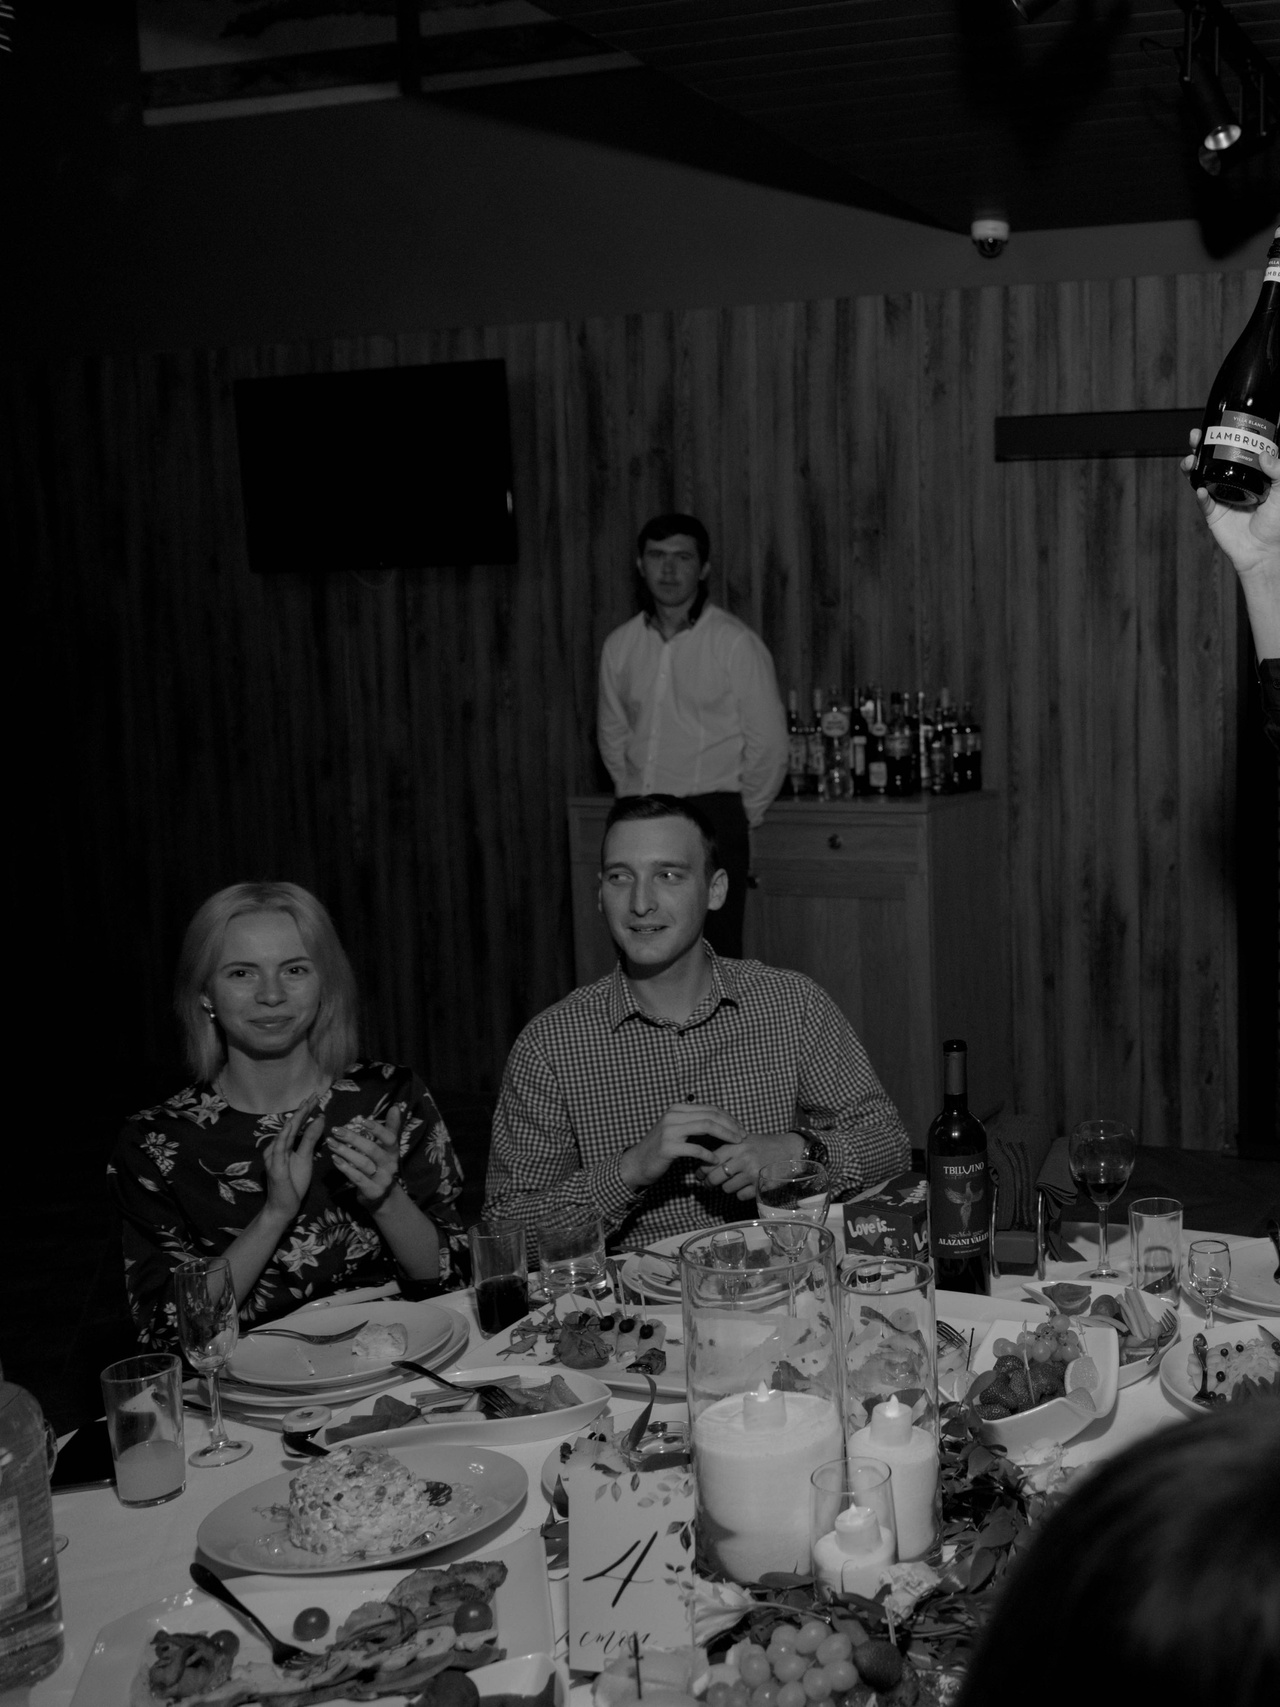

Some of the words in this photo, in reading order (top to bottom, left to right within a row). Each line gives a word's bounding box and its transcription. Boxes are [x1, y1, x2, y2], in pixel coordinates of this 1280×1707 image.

[1248, 419, 1267, 430] BLANCA
[1209, 431, 1276, 457] LAMBRUSCO
[846, 1219, 876, 1238] Love
[938, 1237, 970, 1246] ALAZANI
